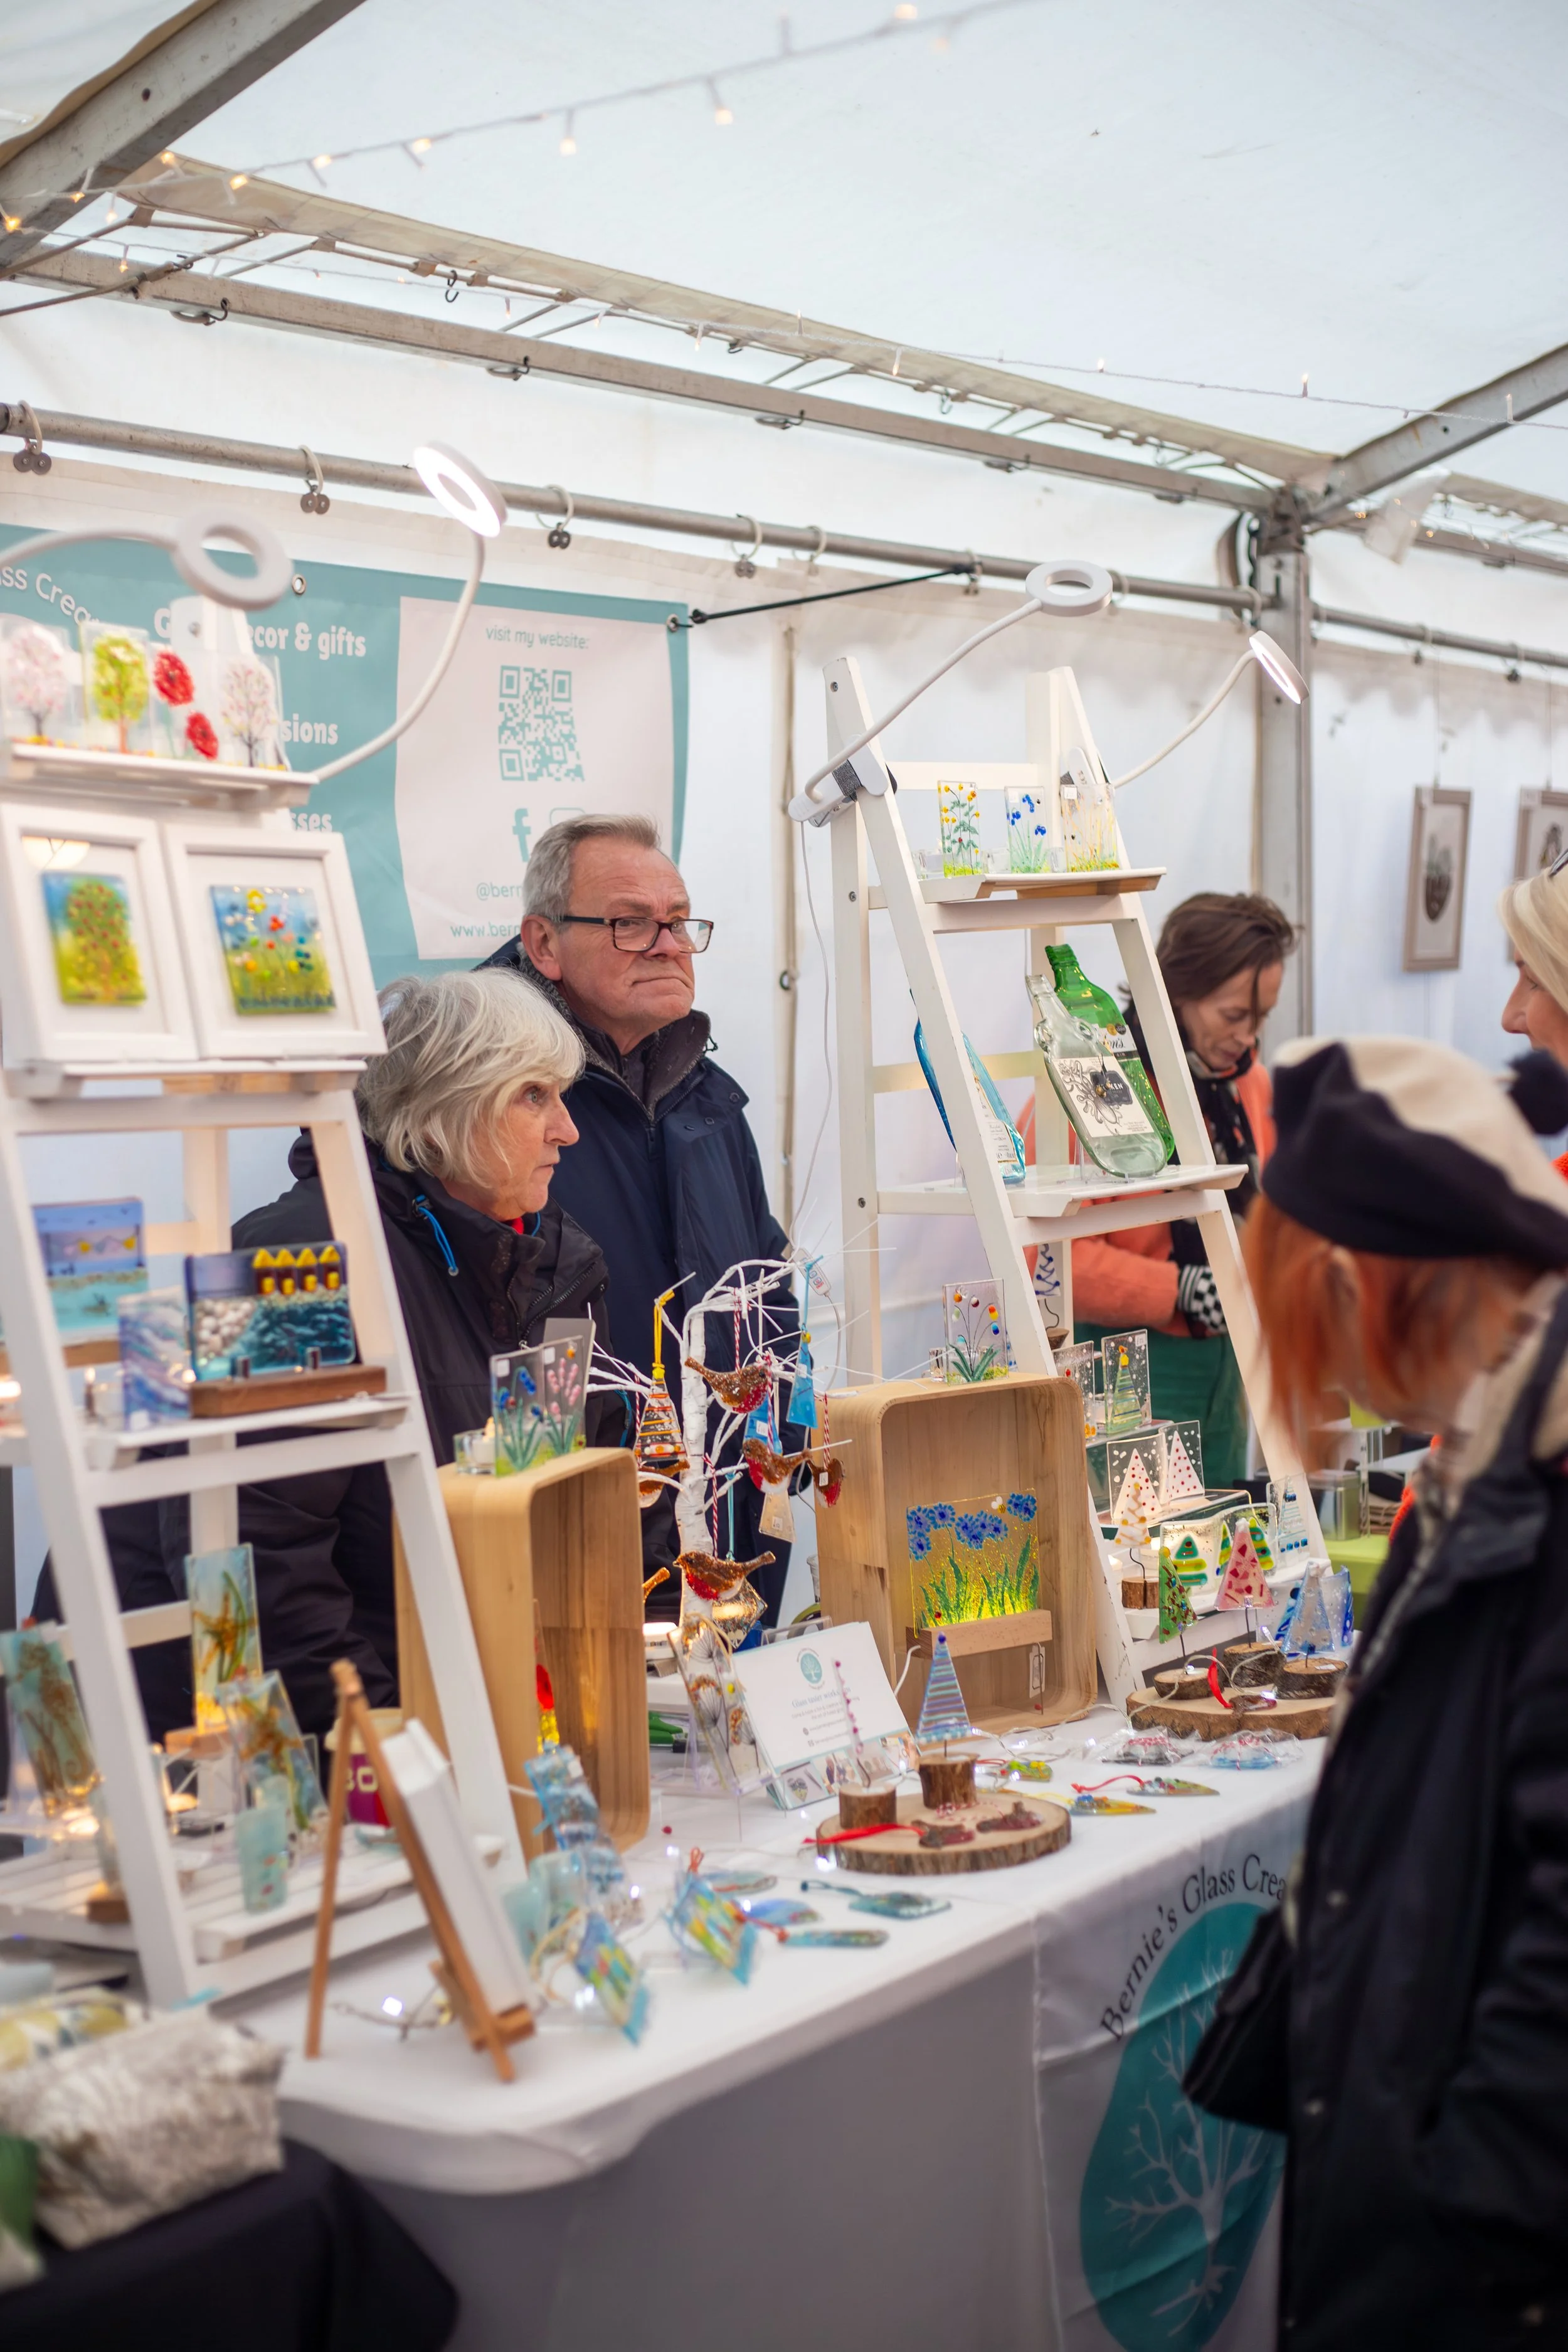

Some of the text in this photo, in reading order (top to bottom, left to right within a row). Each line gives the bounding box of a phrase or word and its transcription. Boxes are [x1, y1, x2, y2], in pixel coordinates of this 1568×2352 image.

[0, 566, 99, 626] ss Crea
[295, 622, 312, 651] &
[317, 626, 366, 660] gifts
[486, 625, 590, 650] visit my website:
[282, 713, 339, 745] sions
[477, 882, 523, 901] @bern
[450, 920, 521, 938] www.bern
[1100, 1854, 1286, 2042] Bernie's Glass Crea
